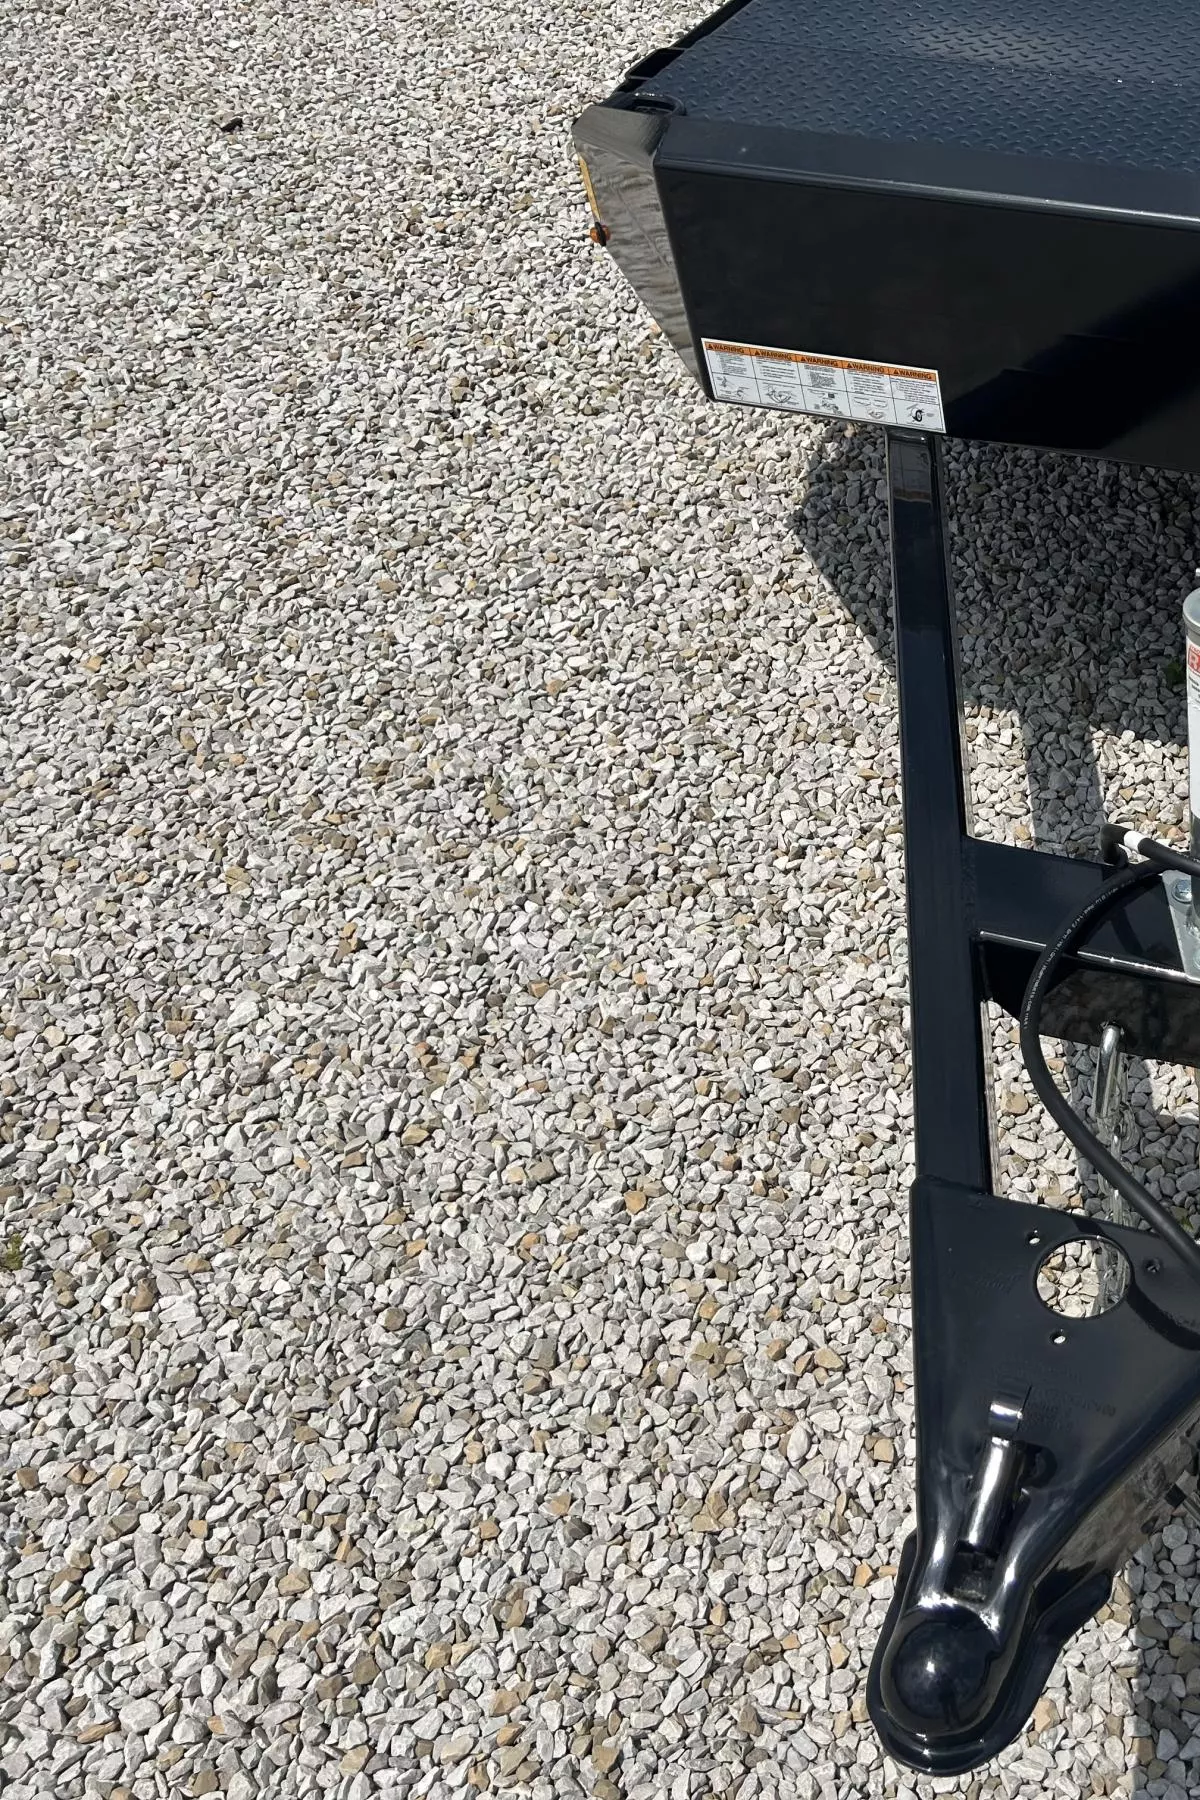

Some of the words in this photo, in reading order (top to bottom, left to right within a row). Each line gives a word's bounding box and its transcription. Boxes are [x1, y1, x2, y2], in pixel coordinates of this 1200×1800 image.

[713, 344, 745, 354] WARNING
[759, 350, 792, 361] WARNING
[806, 356, 838, 367] WARNING
[852, 362, 884, 373] WARNING
[898, 369, 932, 380] WARNING
